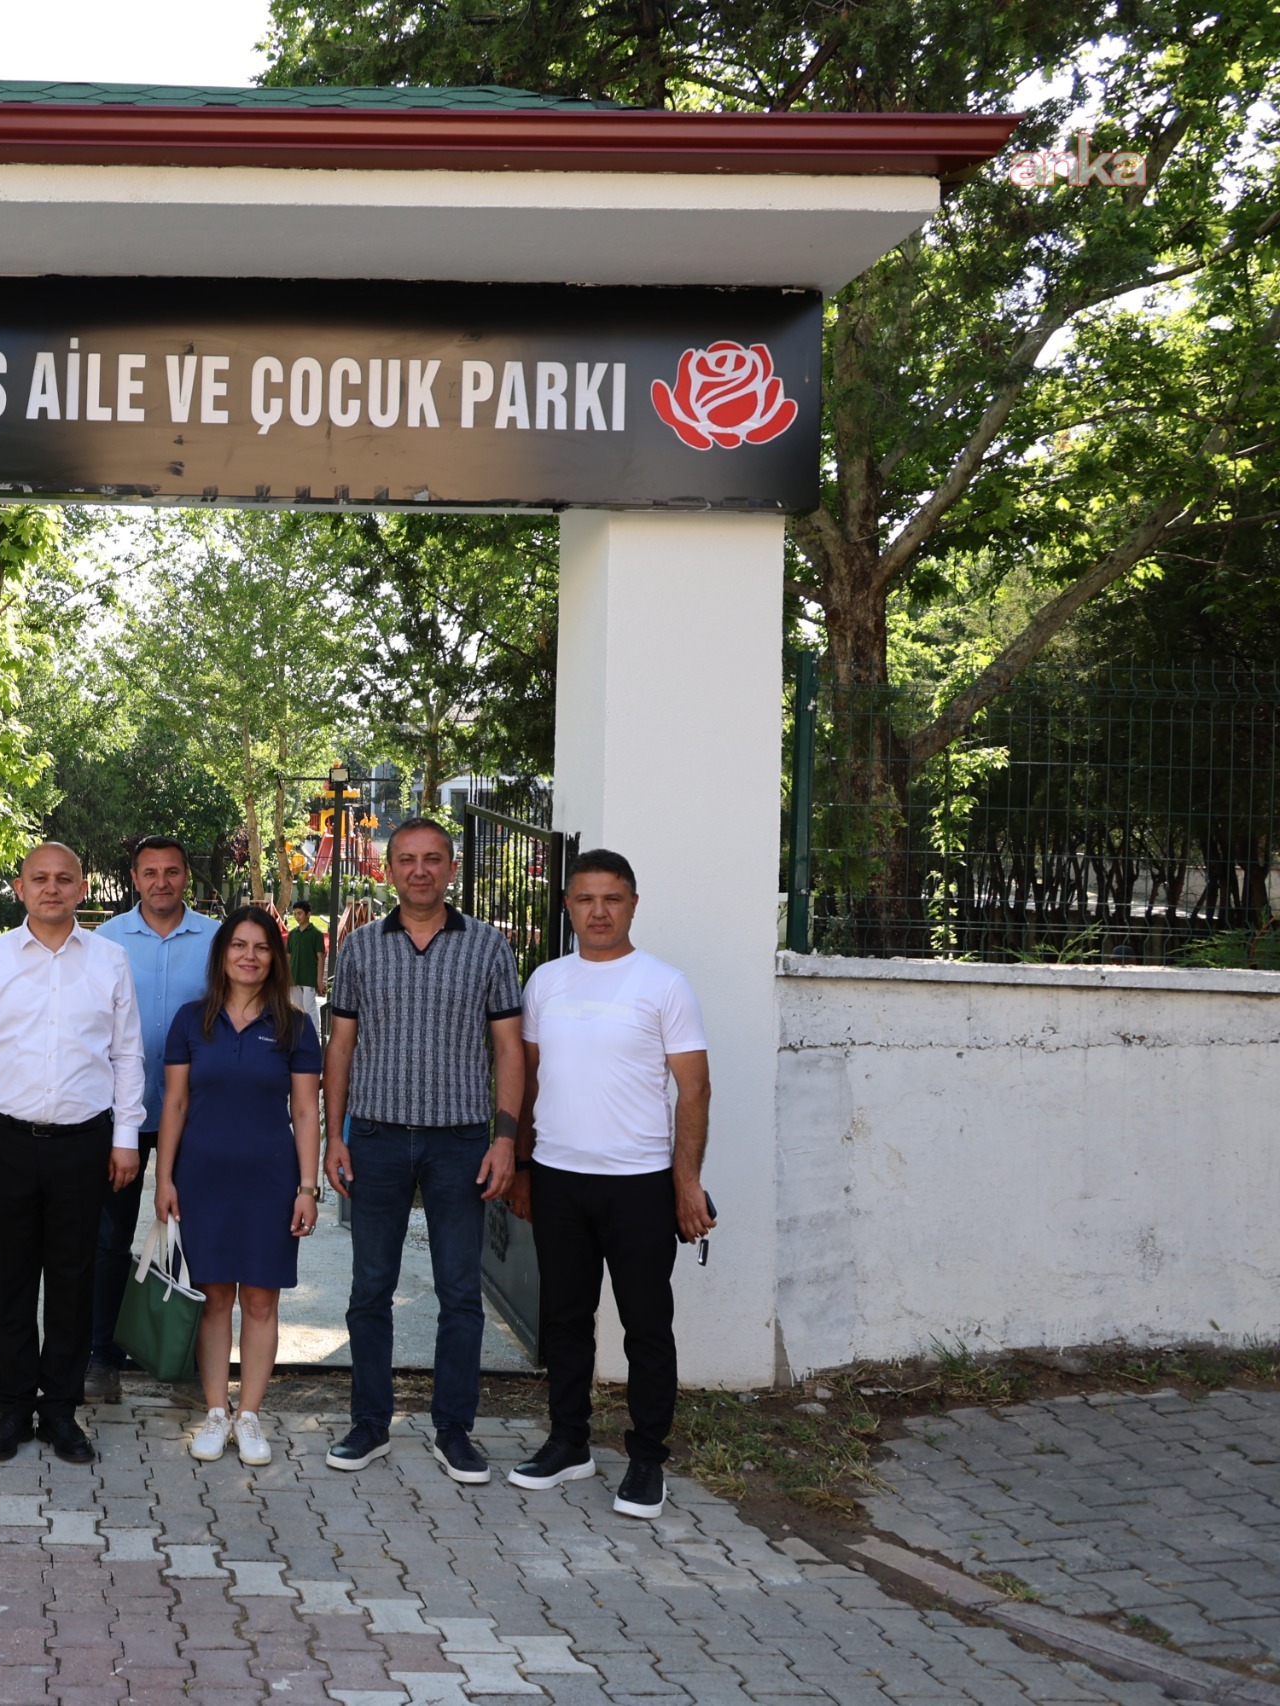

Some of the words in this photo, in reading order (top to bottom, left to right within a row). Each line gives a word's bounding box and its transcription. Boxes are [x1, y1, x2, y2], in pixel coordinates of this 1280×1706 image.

[25, 337, 147, 423] AİLE
[165, 354, 230, 424] VE
[250, 355, 442, 435] ÇOCUK
[460, 360, 626, 432] PARKI
